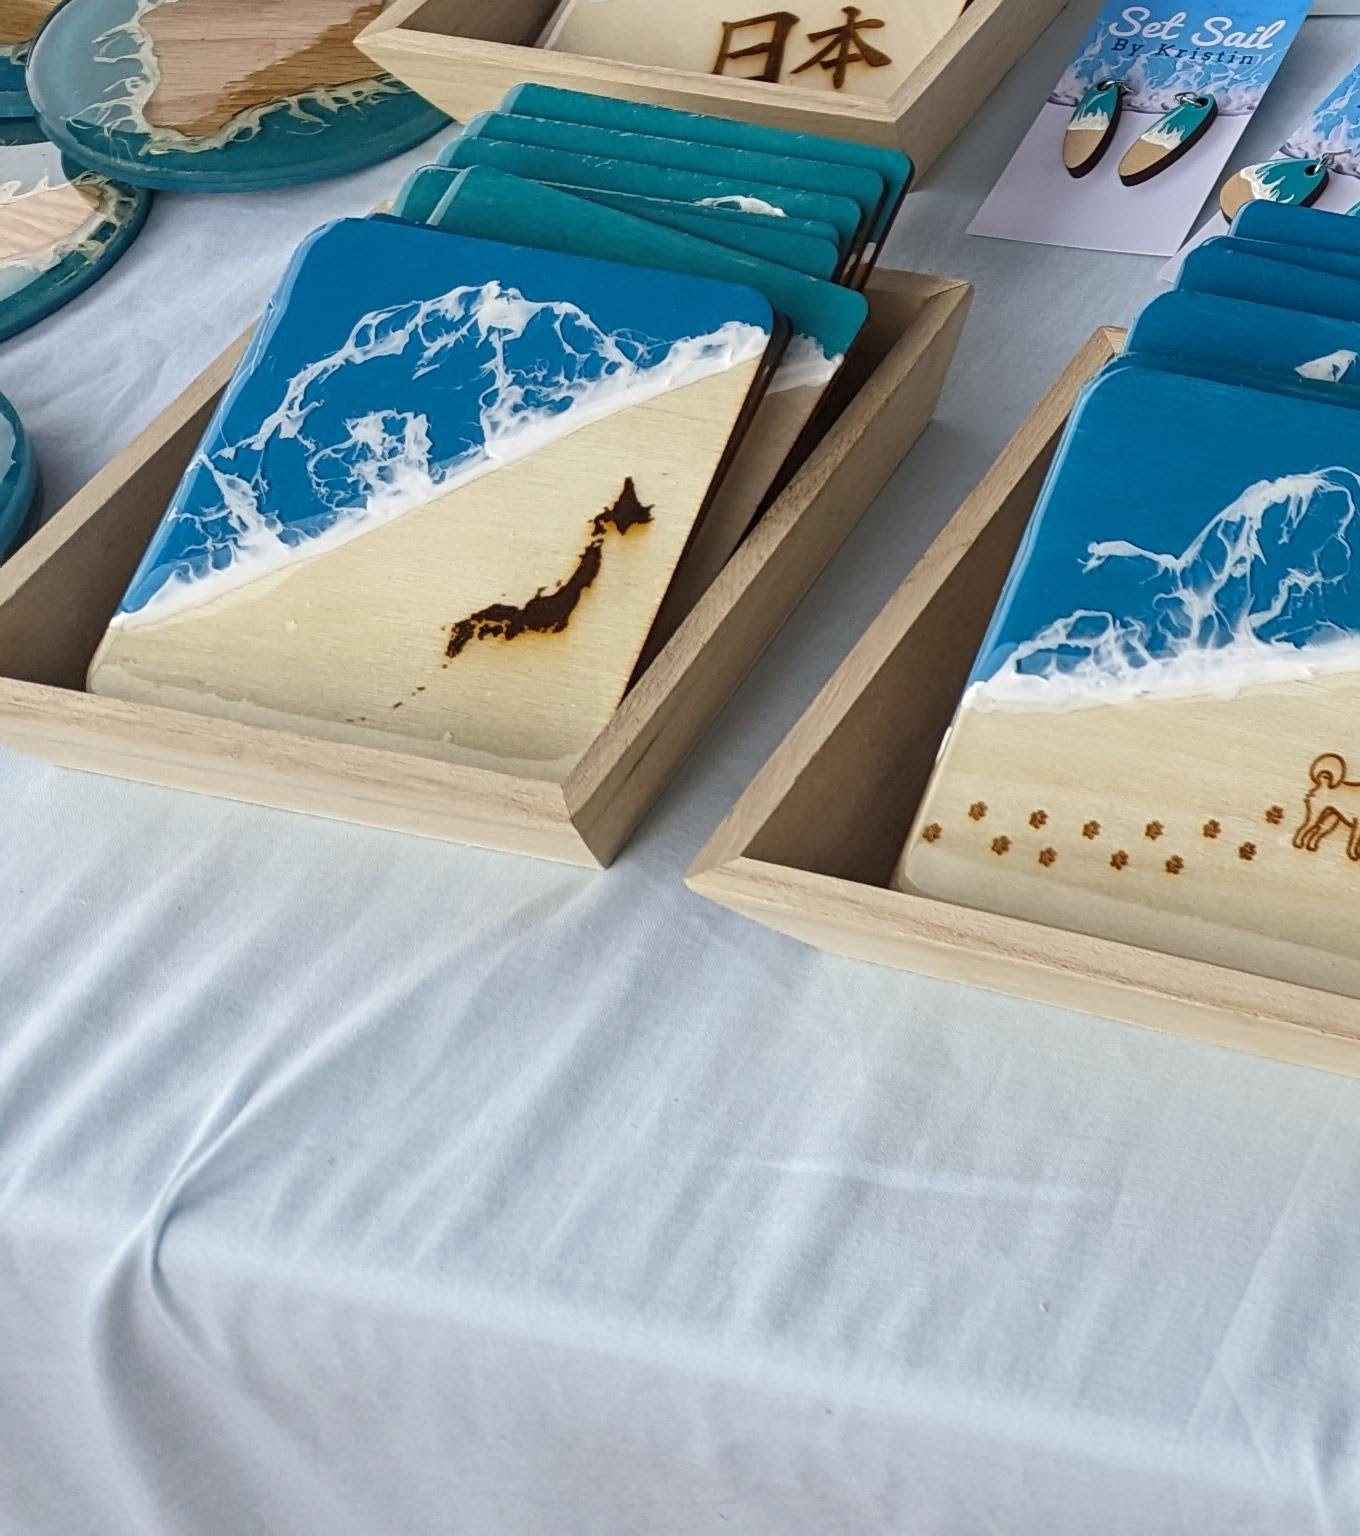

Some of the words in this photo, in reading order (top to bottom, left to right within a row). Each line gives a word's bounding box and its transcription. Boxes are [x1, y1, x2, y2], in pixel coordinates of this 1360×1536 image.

[711, 5, 892, 89] 日本
[1108, 6, 1187, 41] Set
[1190, 16, 1287, 50] Sail
[1111, 37, 1144, 57] By
[1156, 43, 1254, 65] Kristin
